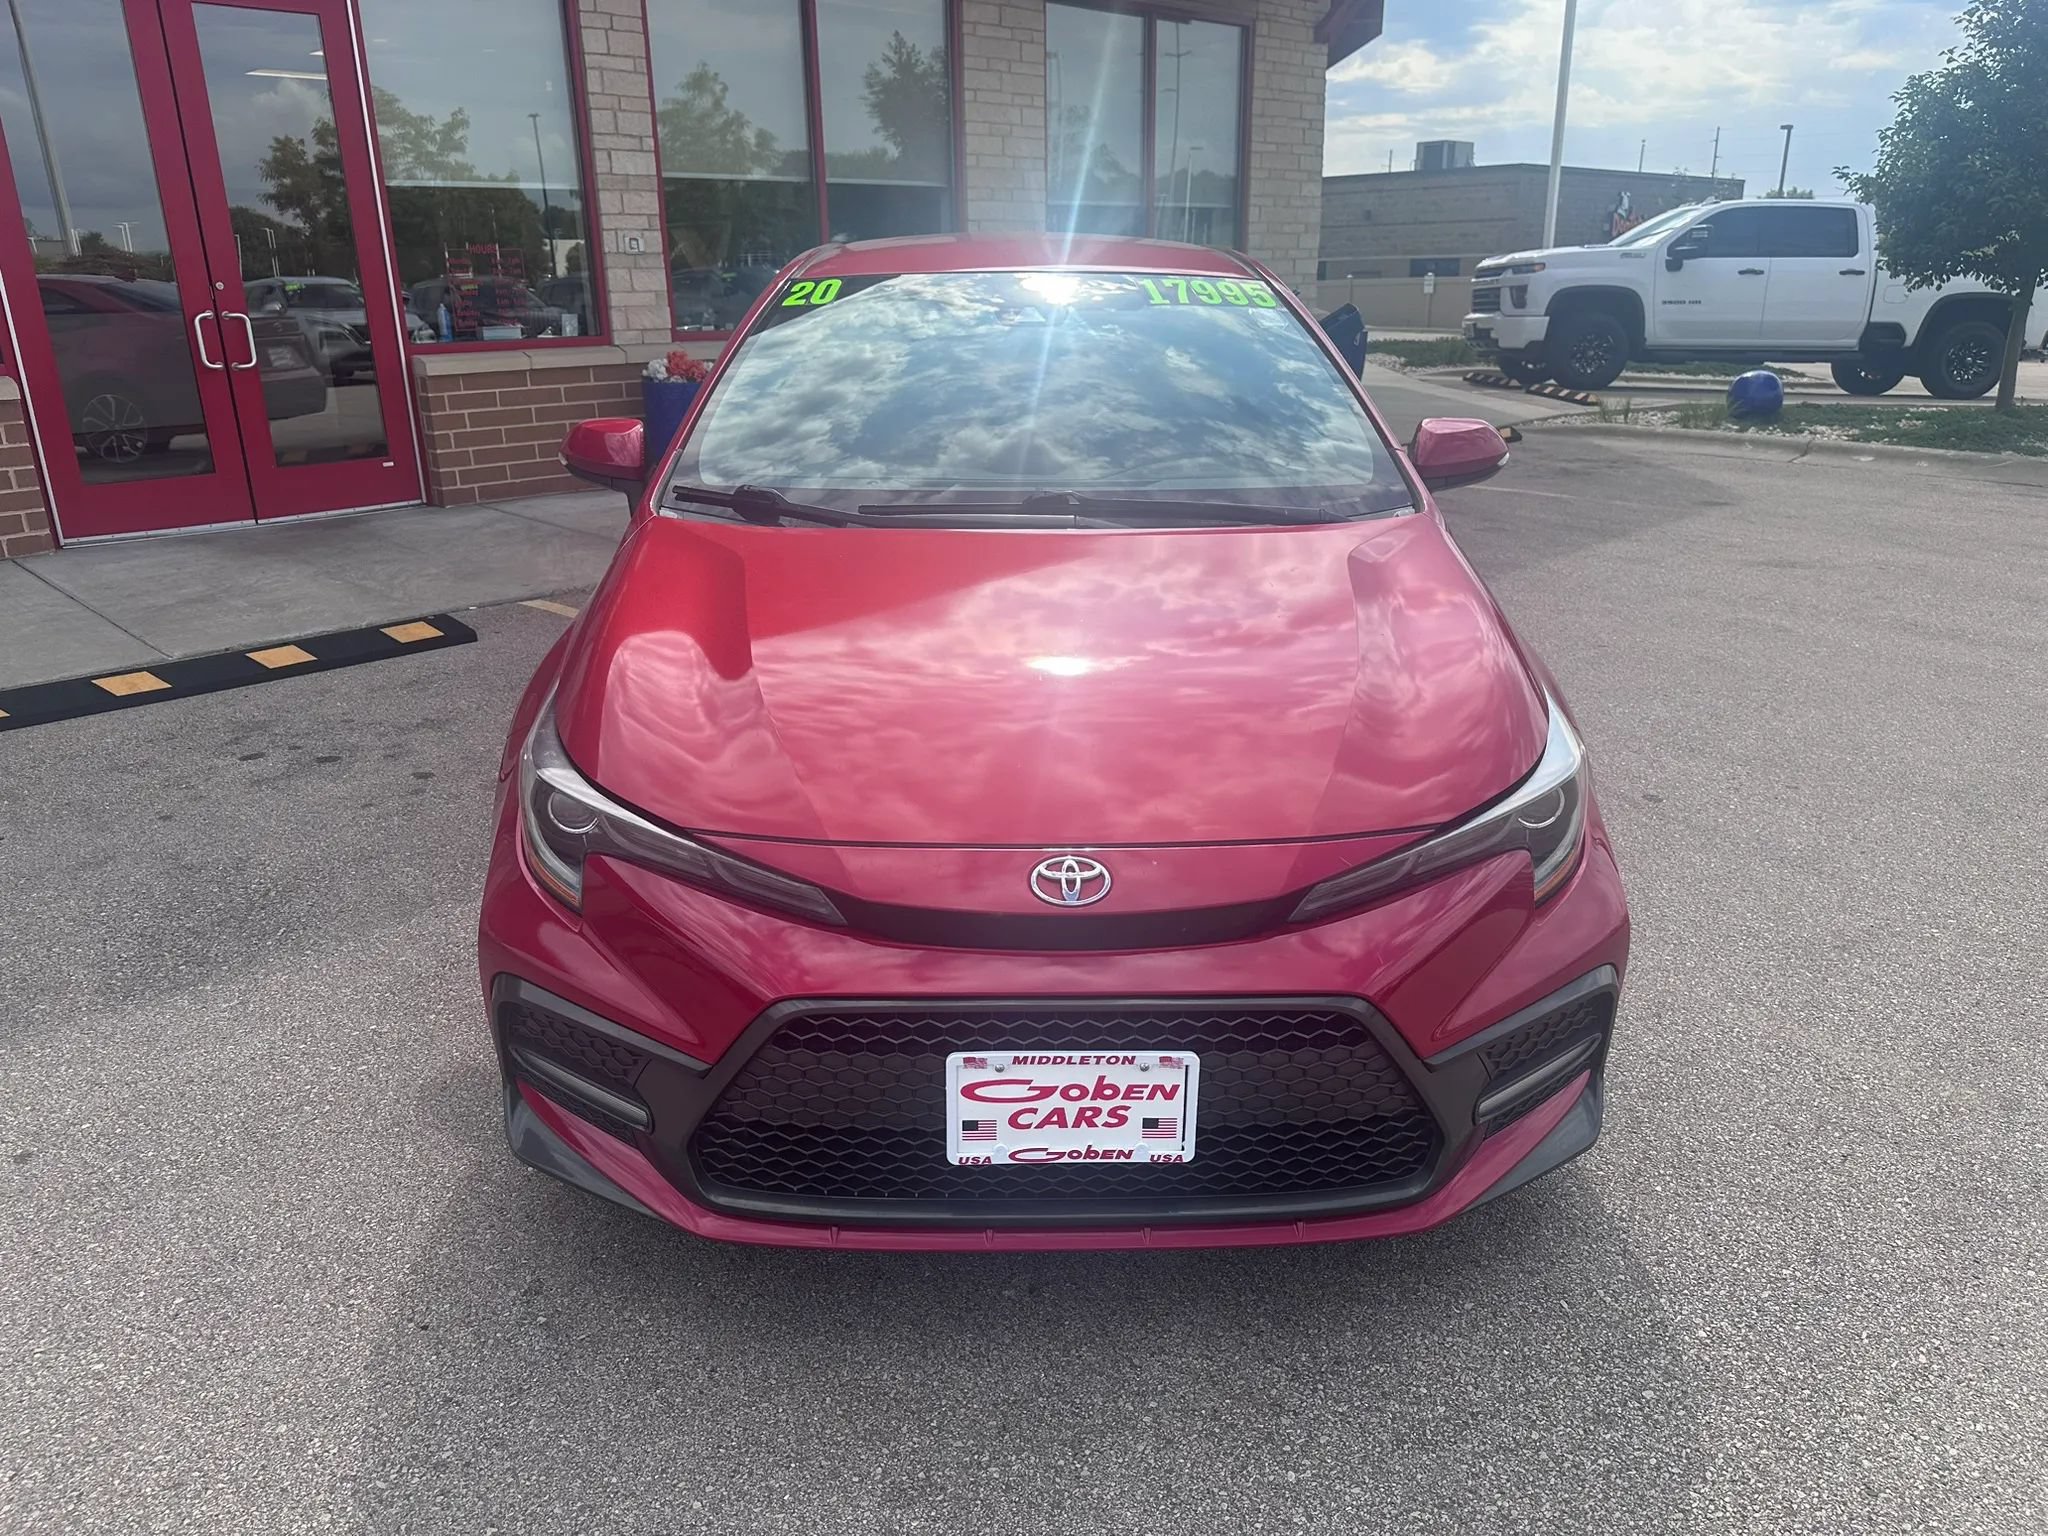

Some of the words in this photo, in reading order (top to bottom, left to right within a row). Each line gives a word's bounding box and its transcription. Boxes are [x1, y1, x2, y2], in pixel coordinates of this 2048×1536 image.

[782, 279, 842, 306] 20
[1140, 278, 1277, 308] 17995
[1012, 1055, 1136, 1065] MIDDLETON
[1008, 1105, 1131, 1130] CARS
[958, 1156, 992, 1165] USA
[1150, 1154, 1183, 1163] USA
